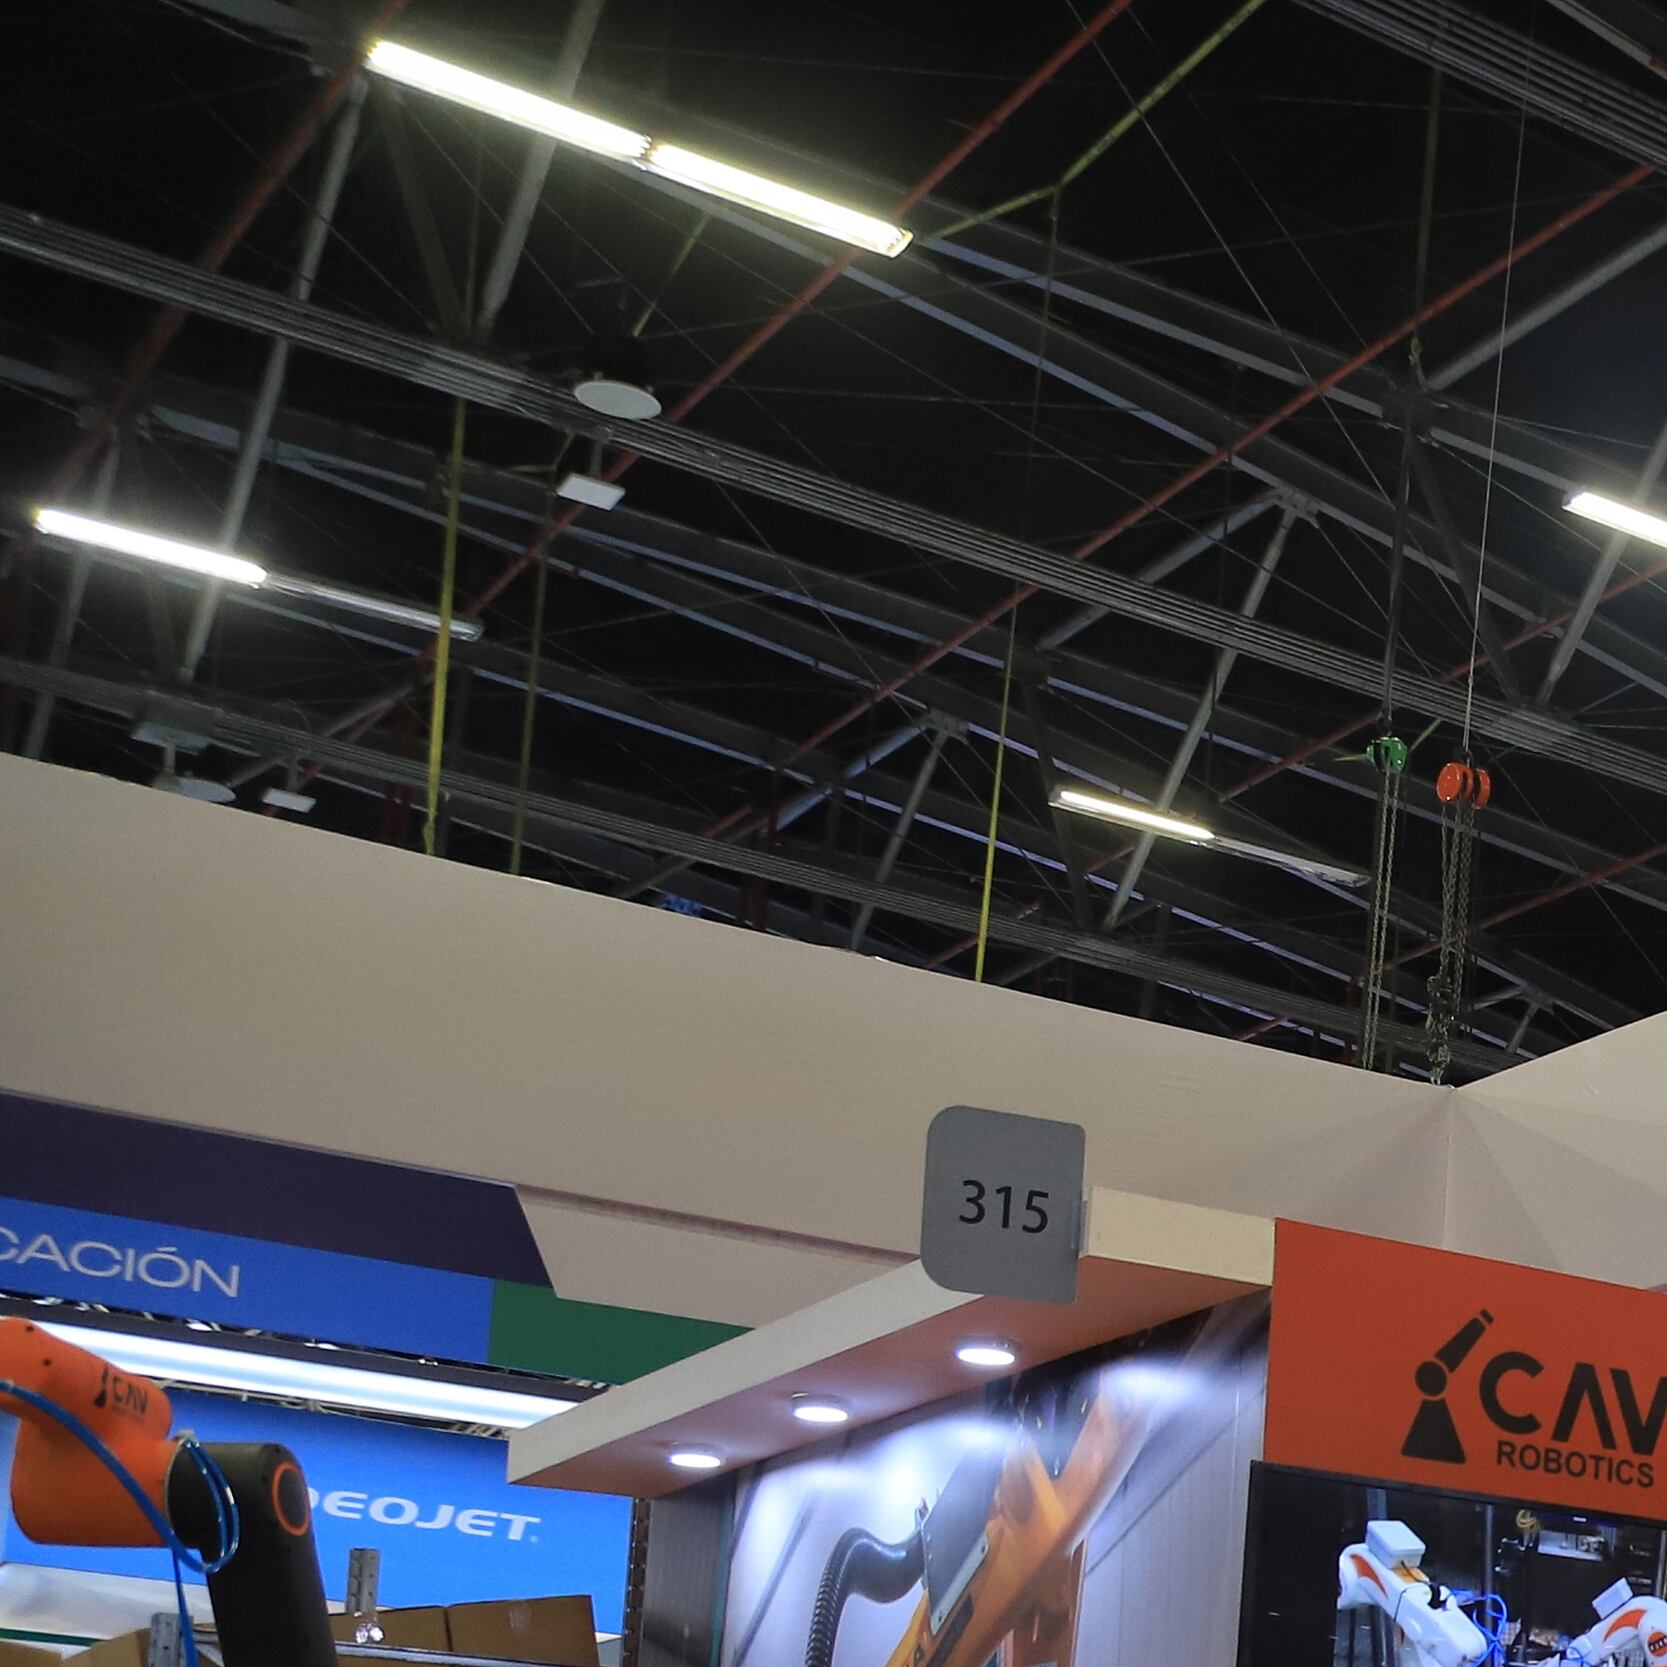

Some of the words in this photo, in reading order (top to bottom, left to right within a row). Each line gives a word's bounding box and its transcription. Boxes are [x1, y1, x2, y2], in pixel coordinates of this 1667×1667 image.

[958, 1180, 1050, 1233] 315
[0, 1226, 240, 1298] ACIÓN
[1496, 1440, 1655, 1489] ROBOTICS
[308, 1487, 542, 1541] EOJET
